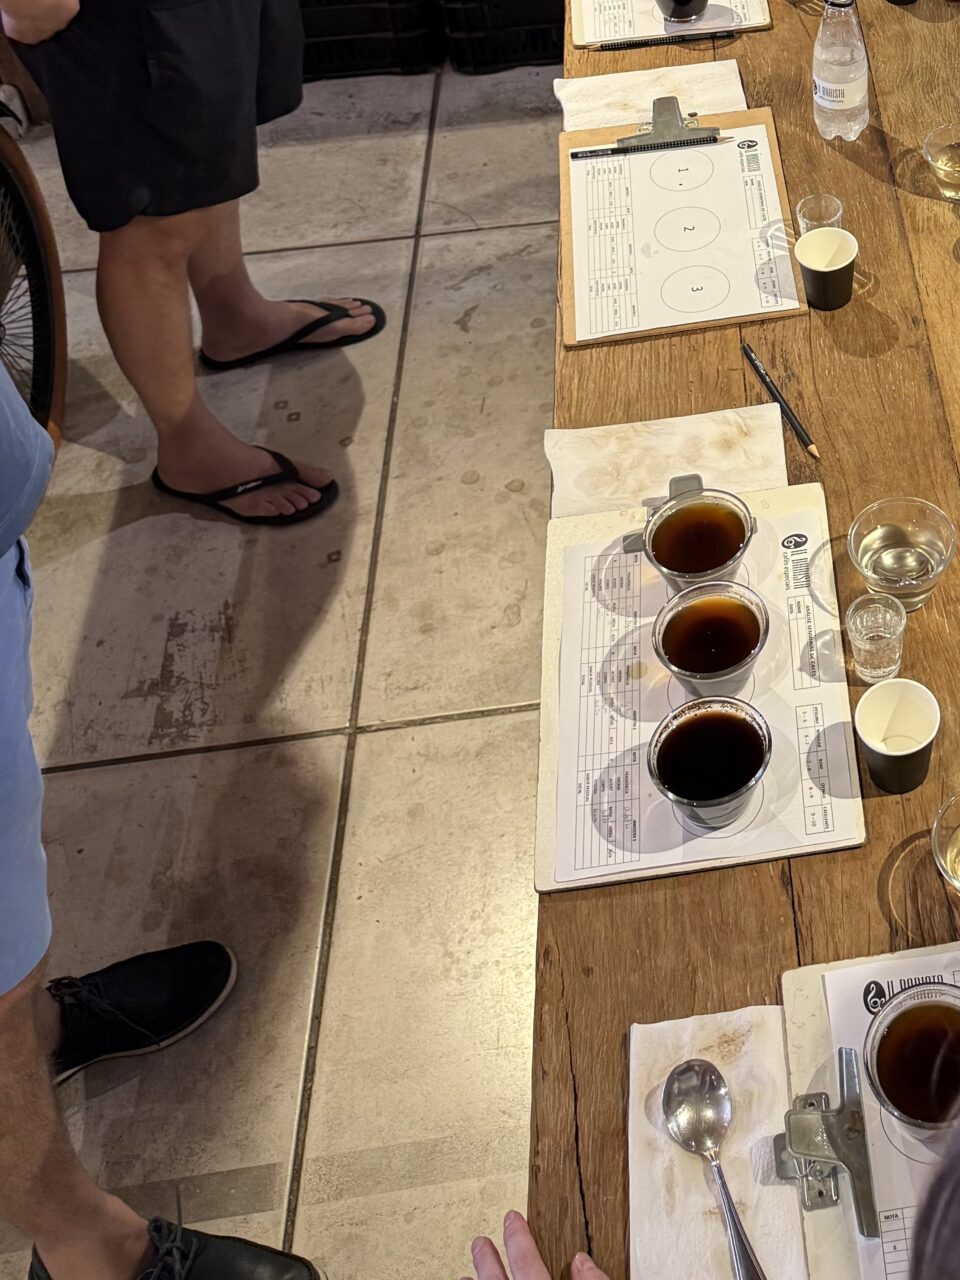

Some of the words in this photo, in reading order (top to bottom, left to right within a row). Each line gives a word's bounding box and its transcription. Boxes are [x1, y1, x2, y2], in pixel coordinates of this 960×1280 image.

[691, 285, 704, 293] 3
[791, 549, 808, 557] IL
[792, 558, 810, 589] BARISTA
